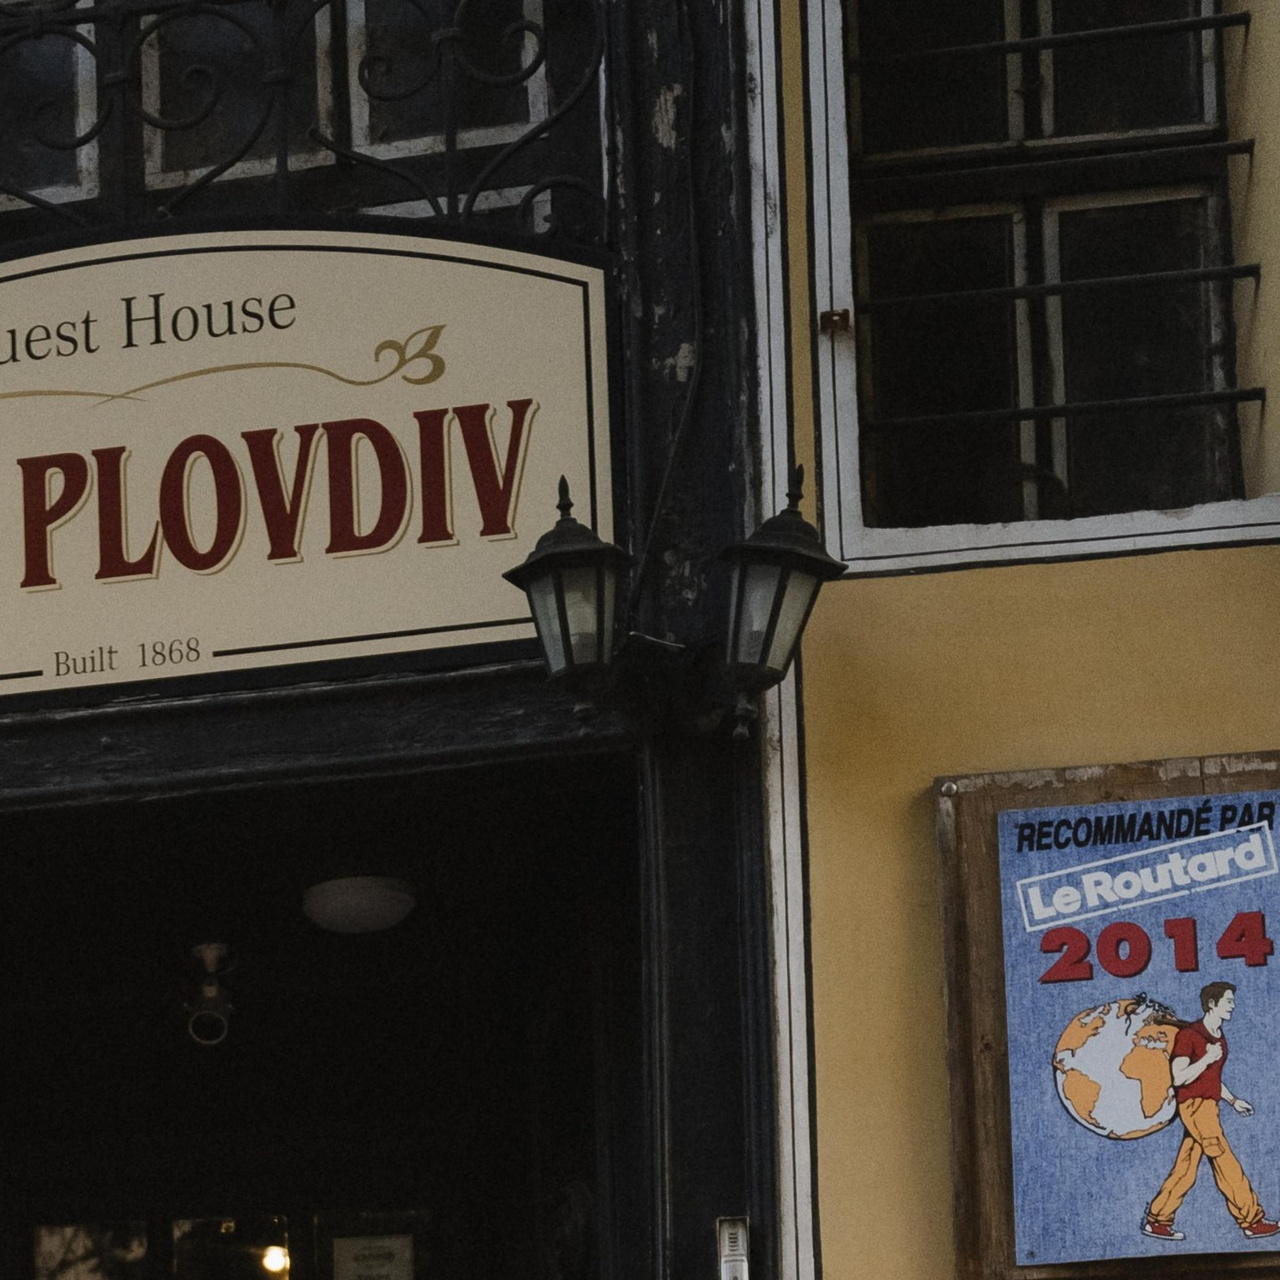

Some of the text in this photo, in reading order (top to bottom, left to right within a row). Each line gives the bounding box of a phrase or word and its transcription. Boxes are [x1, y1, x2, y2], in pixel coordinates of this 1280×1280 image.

[121, 292, 296, 349] House
[16, 398, 540, 592] PLOVDIV
[54, 637, 201, 677] Built 1868
[1015, 799, 1276, 853] RECOMMANDÉ PAR
[1081, 833, 1267, 907] Routard
[1038, 910, 1275, 985] 2014
